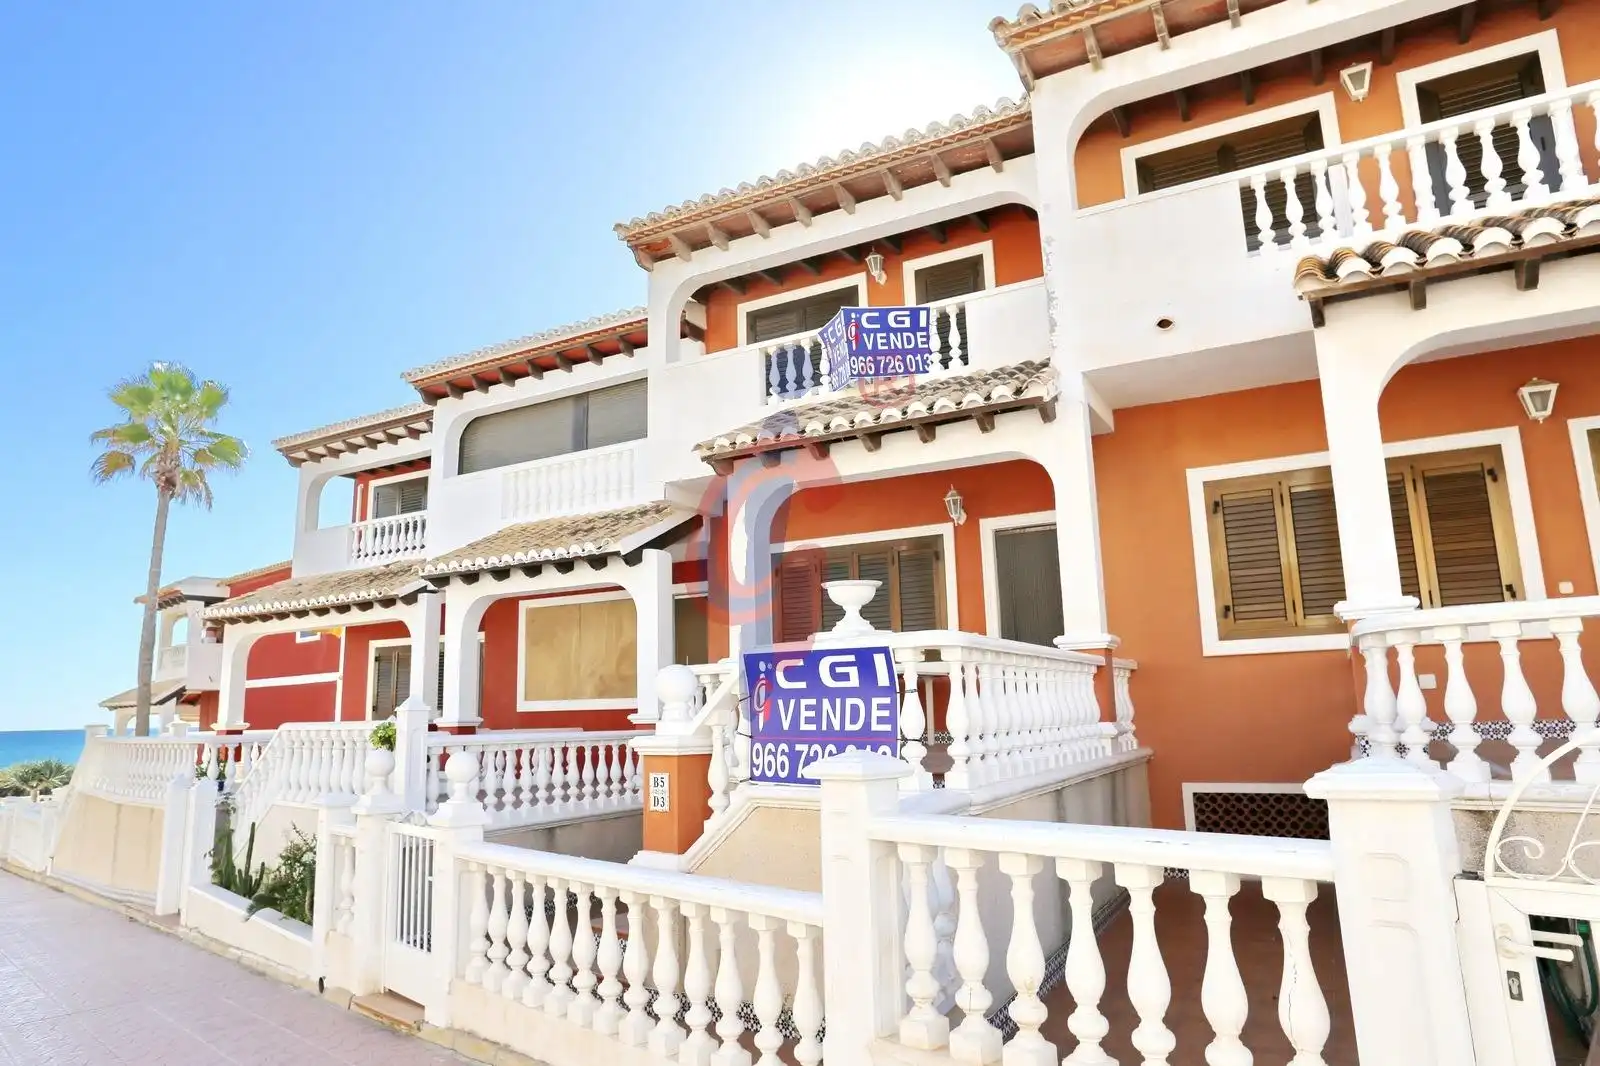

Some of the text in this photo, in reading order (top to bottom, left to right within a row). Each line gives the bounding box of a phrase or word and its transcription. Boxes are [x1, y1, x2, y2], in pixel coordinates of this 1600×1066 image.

[862, 331, 929, 351] VENDE
[850, 355, 875, 375] 966
[876, 354, 904, 374] 726
[777, 696, 892, 732] VENDE
[752, 742, 790, 779] 966
[653, 776, 665, 788] B5
[653, 796, 665, 808] D3
